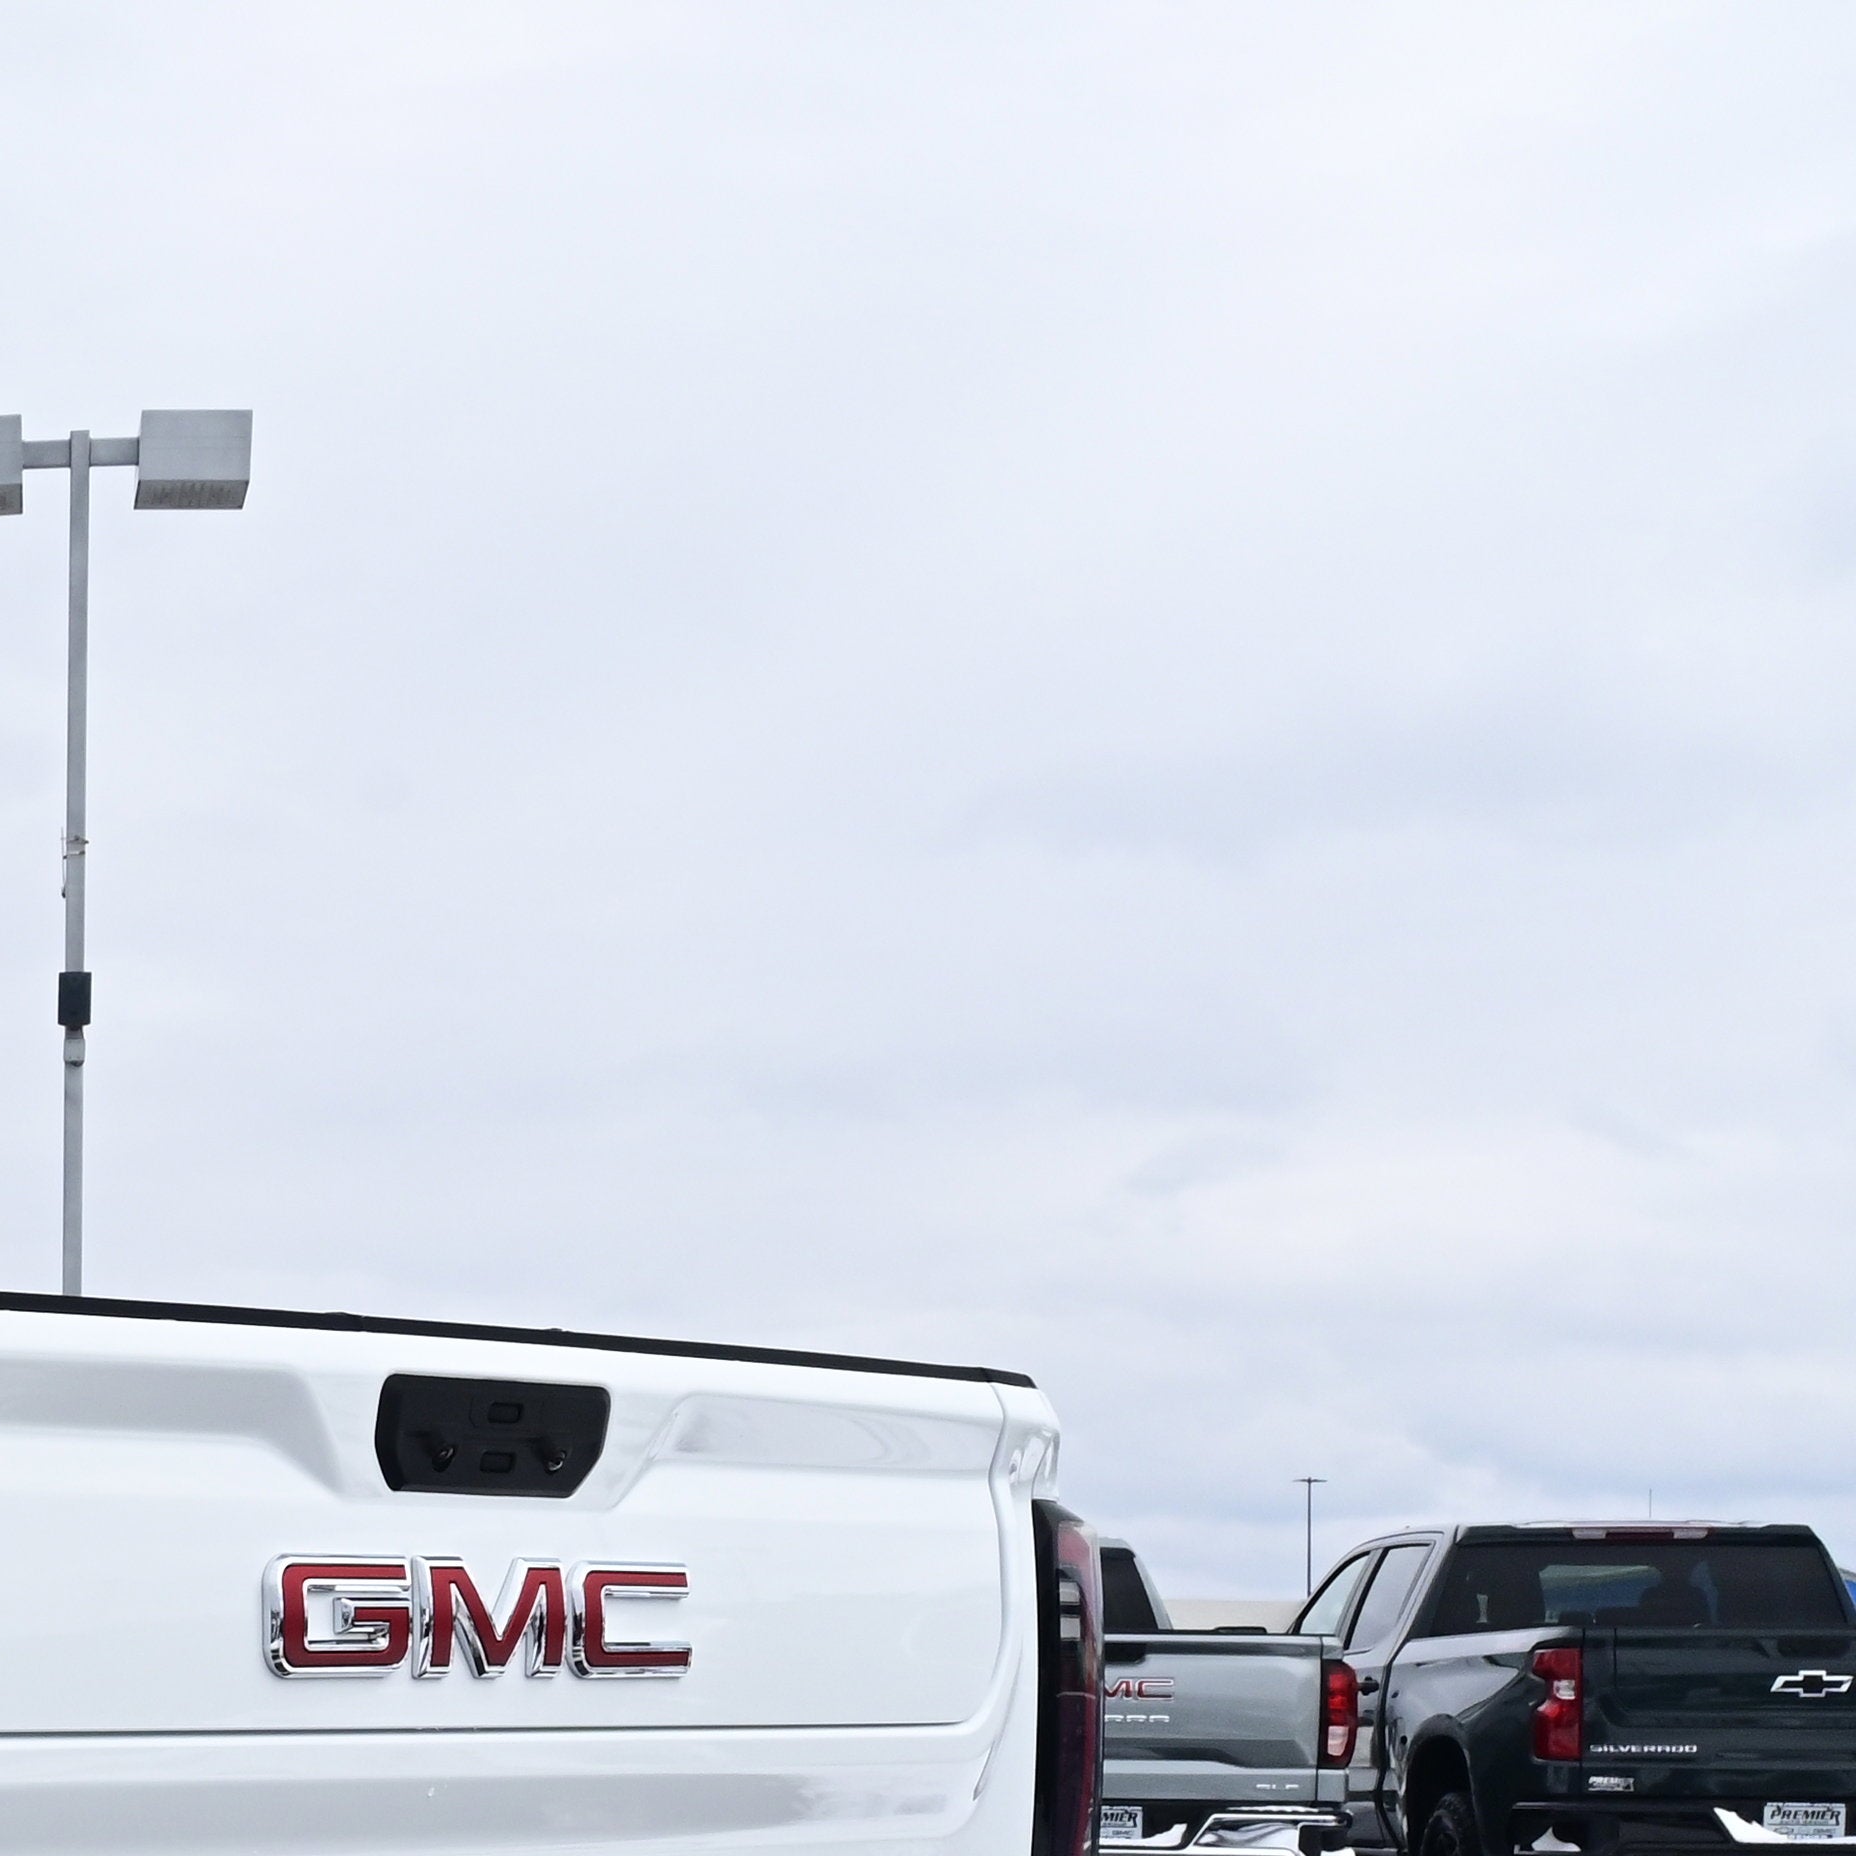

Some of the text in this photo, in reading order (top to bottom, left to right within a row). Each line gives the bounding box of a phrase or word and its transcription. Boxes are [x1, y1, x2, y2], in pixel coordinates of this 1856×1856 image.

[262, 1553, 693, 1679] GMC
[1104, 1678, 1175, 1702] MC
[1590, 1744, 1697, 1753] SILVERADO
[1100, 1811, 1138, 1828] MIER
[1770, 1805, 1841, 1826] PREMIER
